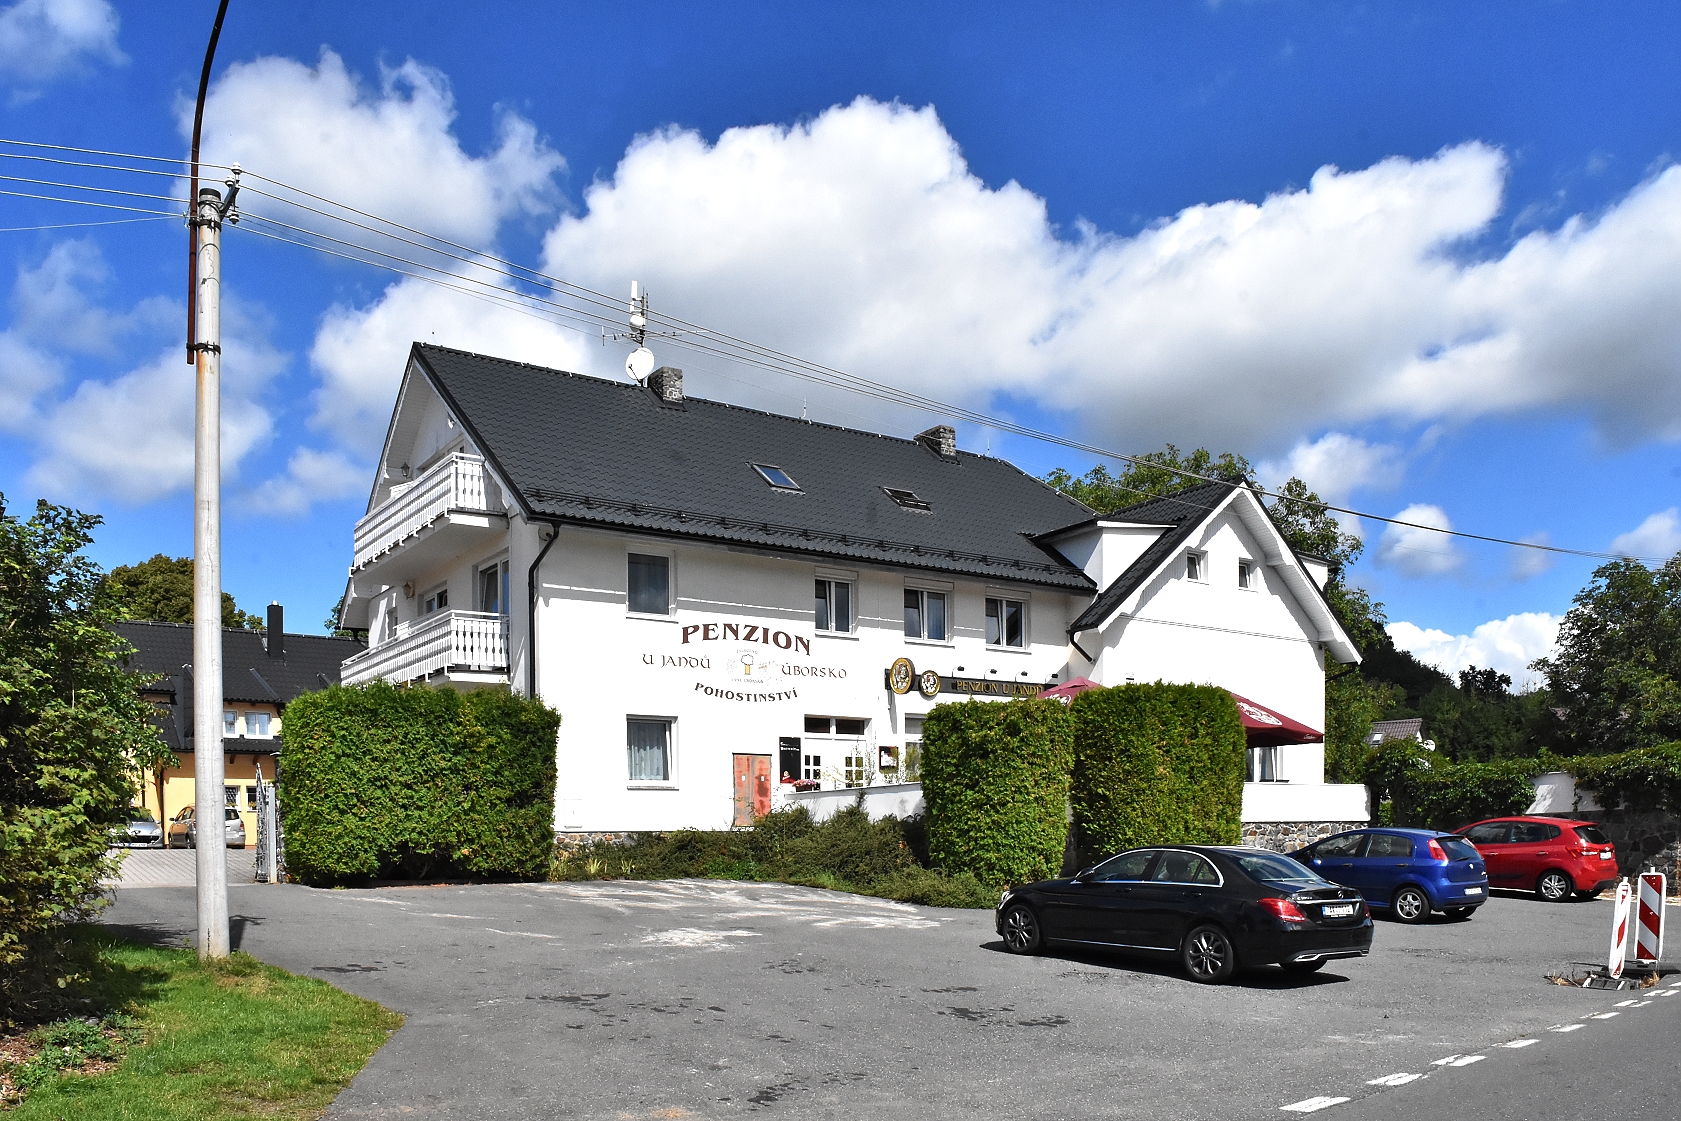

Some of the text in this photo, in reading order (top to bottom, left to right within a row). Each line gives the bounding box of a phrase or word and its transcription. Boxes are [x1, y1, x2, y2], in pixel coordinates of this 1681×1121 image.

[681, 622, 811, 656] PENZION
[642, 653, 711, 669] U JANDŮ
[781, 662, 847, 679] ÚBORSKO
[694, 681, 798, 703] POHOSTINSTVÍ
[956, 680, 998, 694] PENZION
[1002, 683, 1010, 694] U
